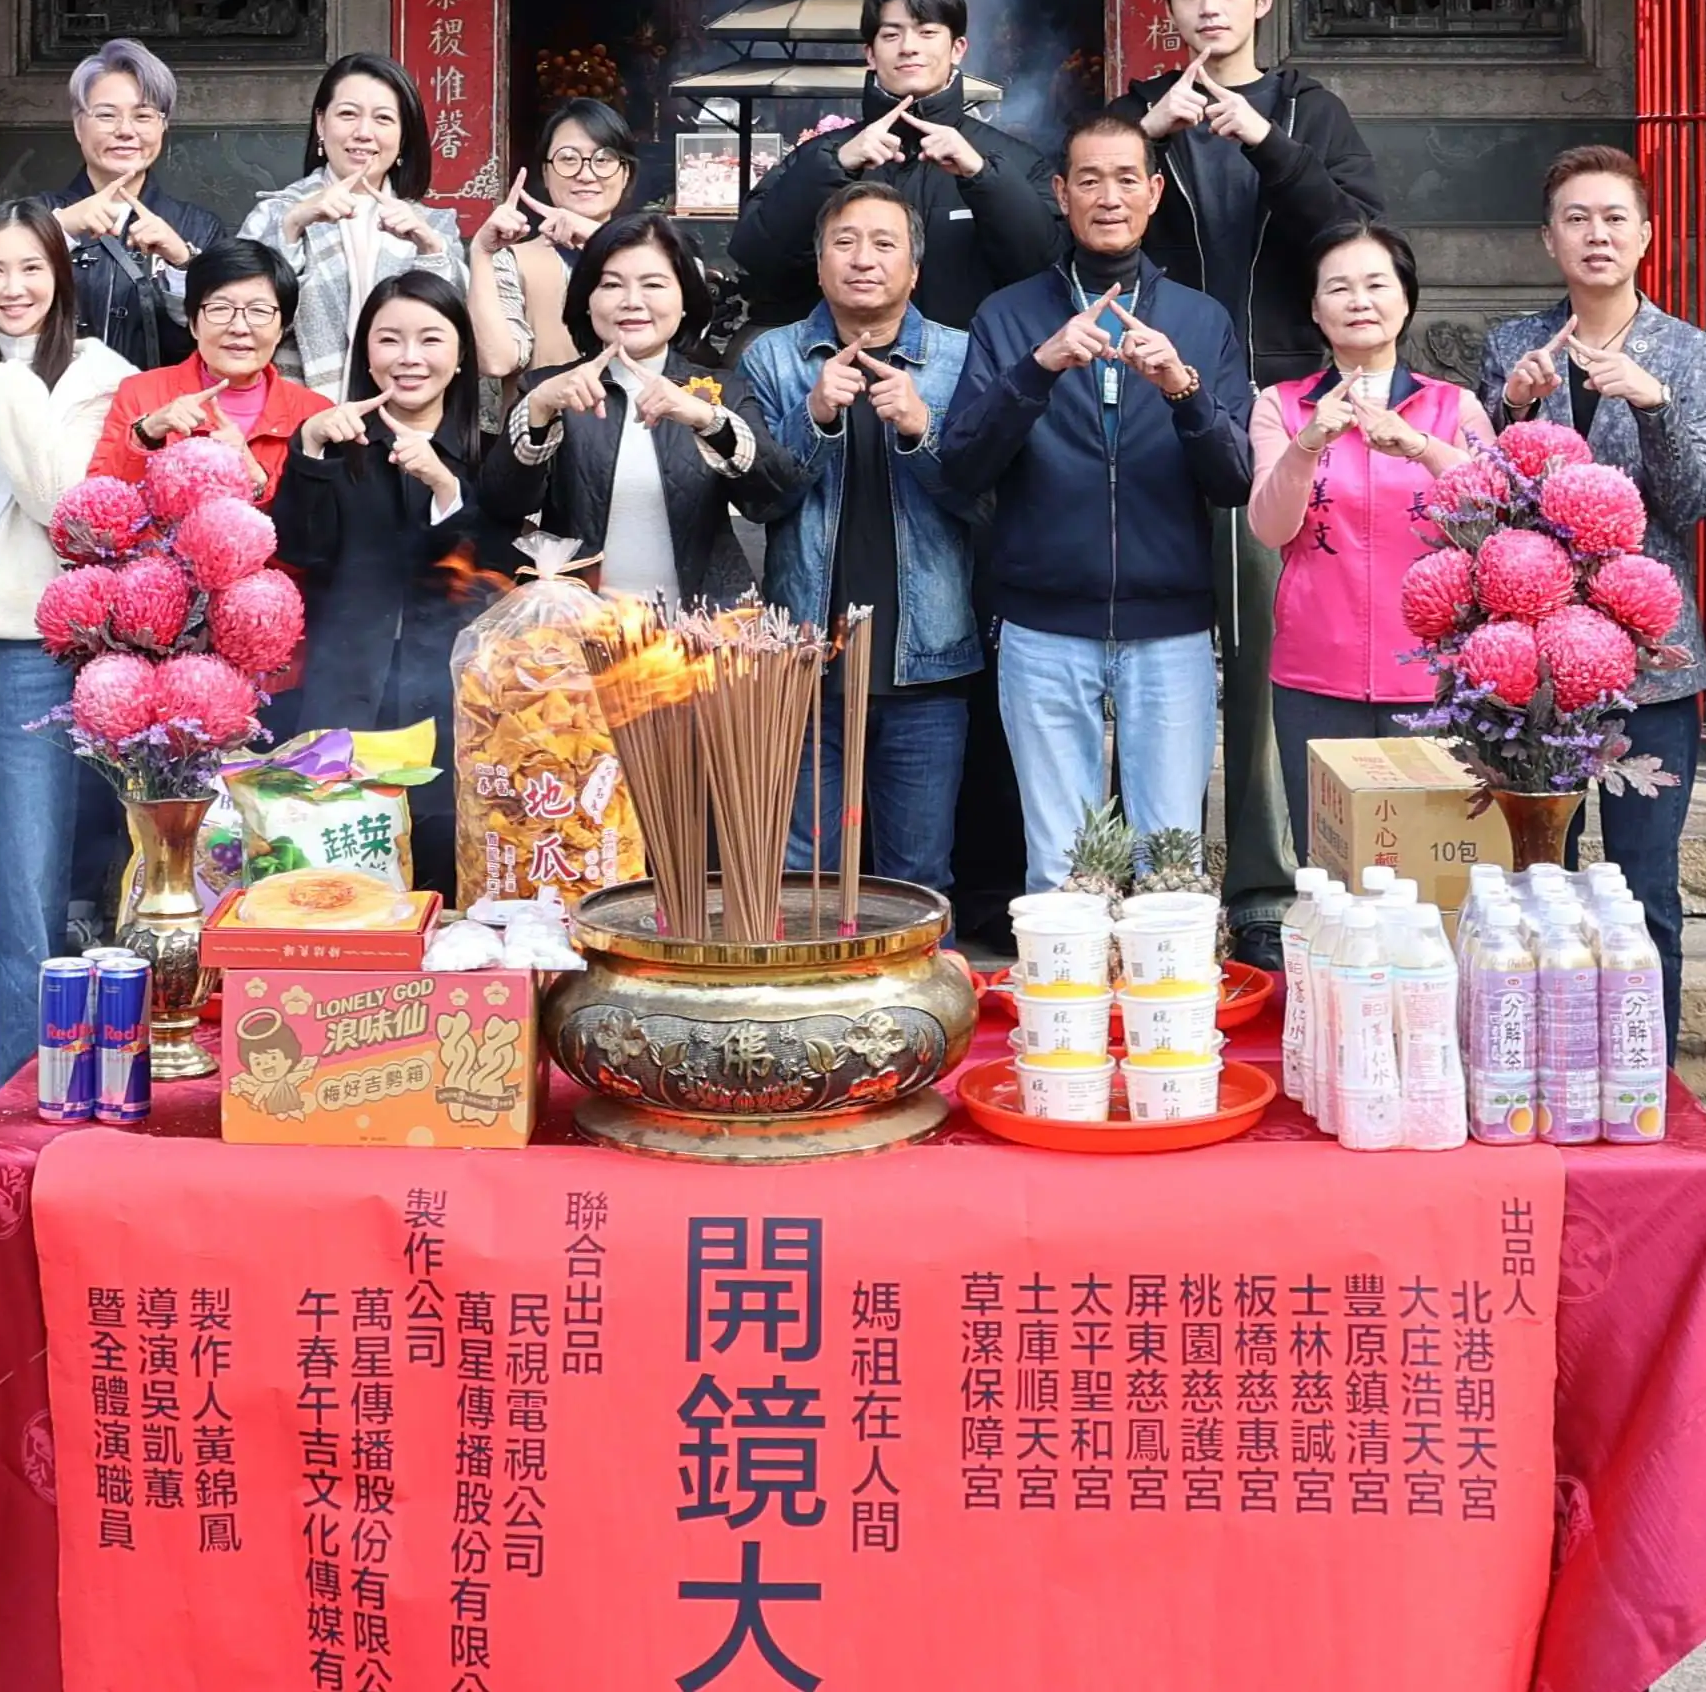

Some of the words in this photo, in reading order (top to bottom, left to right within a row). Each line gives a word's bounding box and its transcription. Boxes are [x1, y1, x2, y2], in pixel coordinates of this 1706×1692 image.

[320, 813, 392, 864] 蔬菜
[524, 771, 580, 881] 地瓜
[1430, 840, 1479, 864] 10包
[46, 1022, 78, 1041] Red
[104, 1024, 135, 1041] Red
[315, 988, 387, 1020] LONELY
[392, 977, 437, 1002] GOD
[322, 1064, 425, 1105] 梅好吉勢箱
[323, 1001, 429, 1056] 浪味仙
[1503, 995, 1524, 1071] 分解茶
[1625, 995, 1649, 1069] 分解茶
[404, 1186, 446, 1370] 製作公司
[562, 1190, 609, 1377] 聯合出品
[1499, 1195, 1537, 1318] 出品人
[86, 1287, 136, 1553] 暨全體演職員
[137, 1287, 185, 1511] 導演吳凱蕙
[190, 1287, 242, 1555] 製作人黃錦鳳
[502, 1293, 550, 1579] 民視電視公司
[675, 1215, 827, 1692] 開鏡大
[849, 1280, 902, 1555] 媽祖在人間
[960, 1271, 1005, 1511] 草漯保障宮
[1015, 1271, 1060, 1511] 土庫順天宮
[1070, 1272, 1114, 1511] 太平聖和宮
[1125, 1273, 1170, 1512] 屏東慈鳳宮
[1179, 1273, 1224, 1513] 桃園慈護宮
[1234, 1273, 1280, 1514] 板橋慈惠宮
[1343, 1273, 1390, 1515] 豐原鎮清宮
[1398, 1275, 1445, 1516] 大庄浩天宮
[1451, 1281, 1498, 1522] 北港朝天宮
